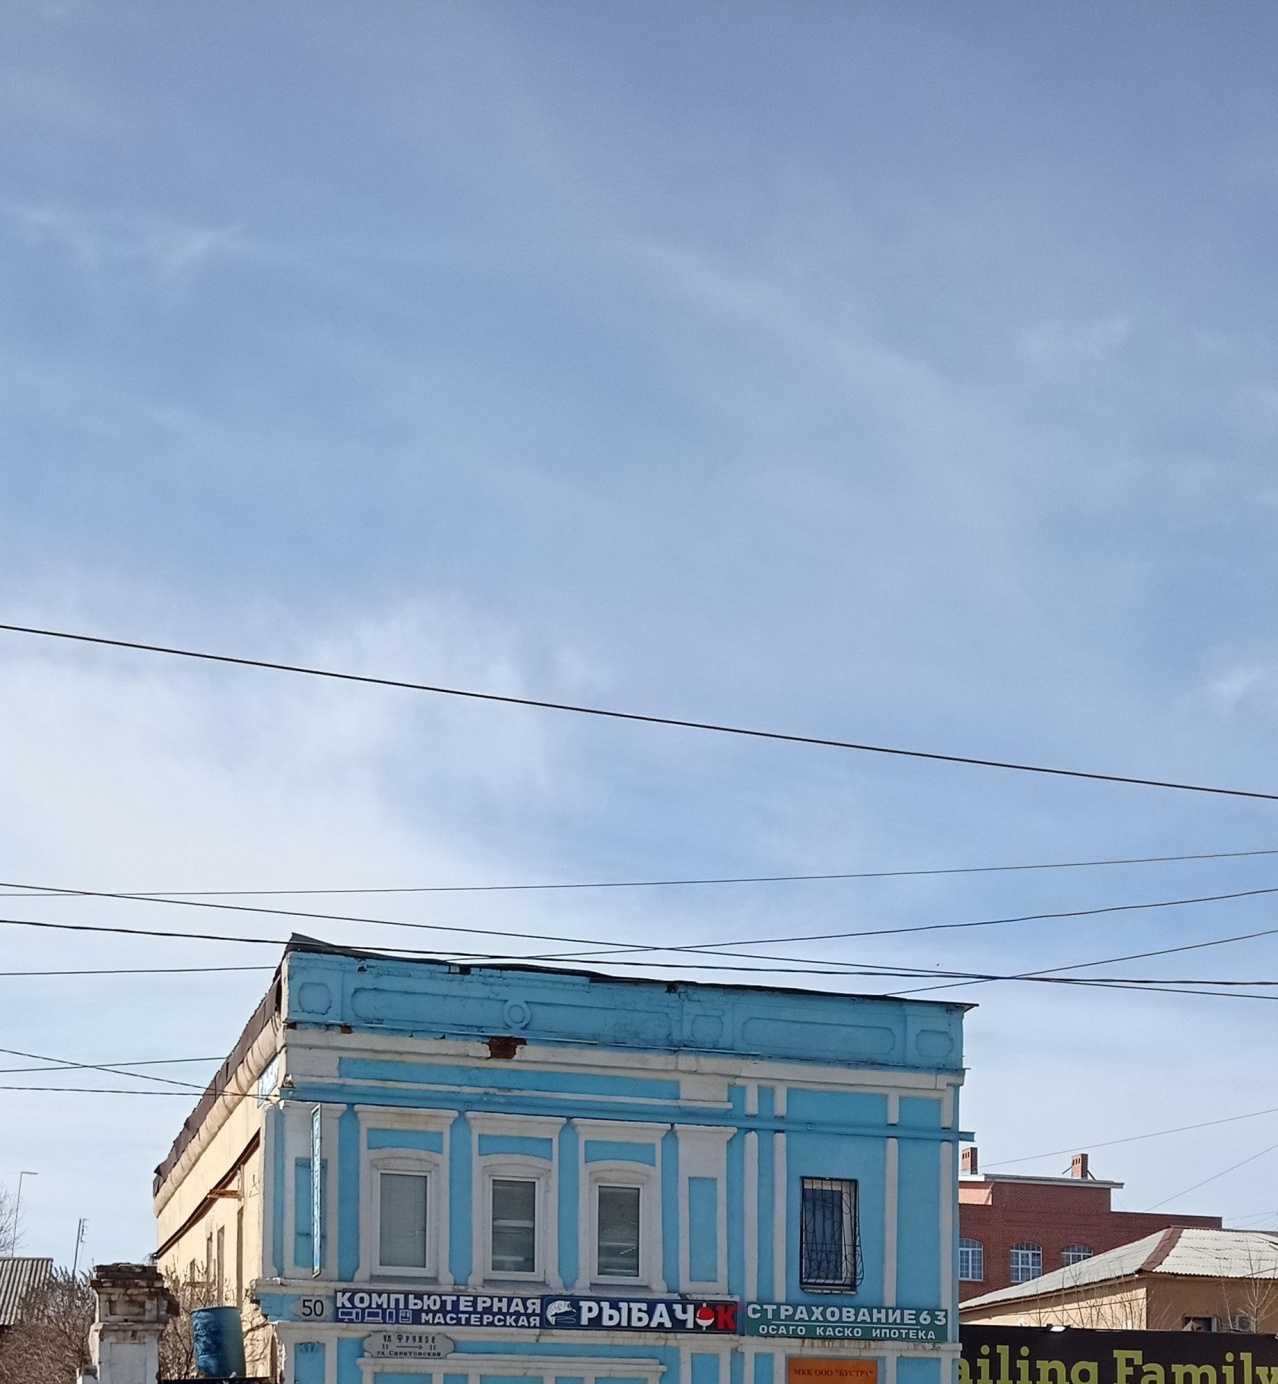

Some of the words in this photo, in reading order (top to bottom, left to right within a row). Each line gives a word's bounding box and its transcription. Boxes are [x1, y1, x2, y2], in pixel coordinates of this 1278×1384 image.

[301, 1299, 324, 1318] 50
[336, 1291, 541, 1314] КОМПЬЮТЕРНАЯ
[421, 1313, 540, 1328] МАСТЕРСКАЯ
[759, 1324, 806, 1336] ОСАГО
[816, 1326, 862, 1338] КАСКО
[872, 1328, 936, 1341] ИПОТЕКА
